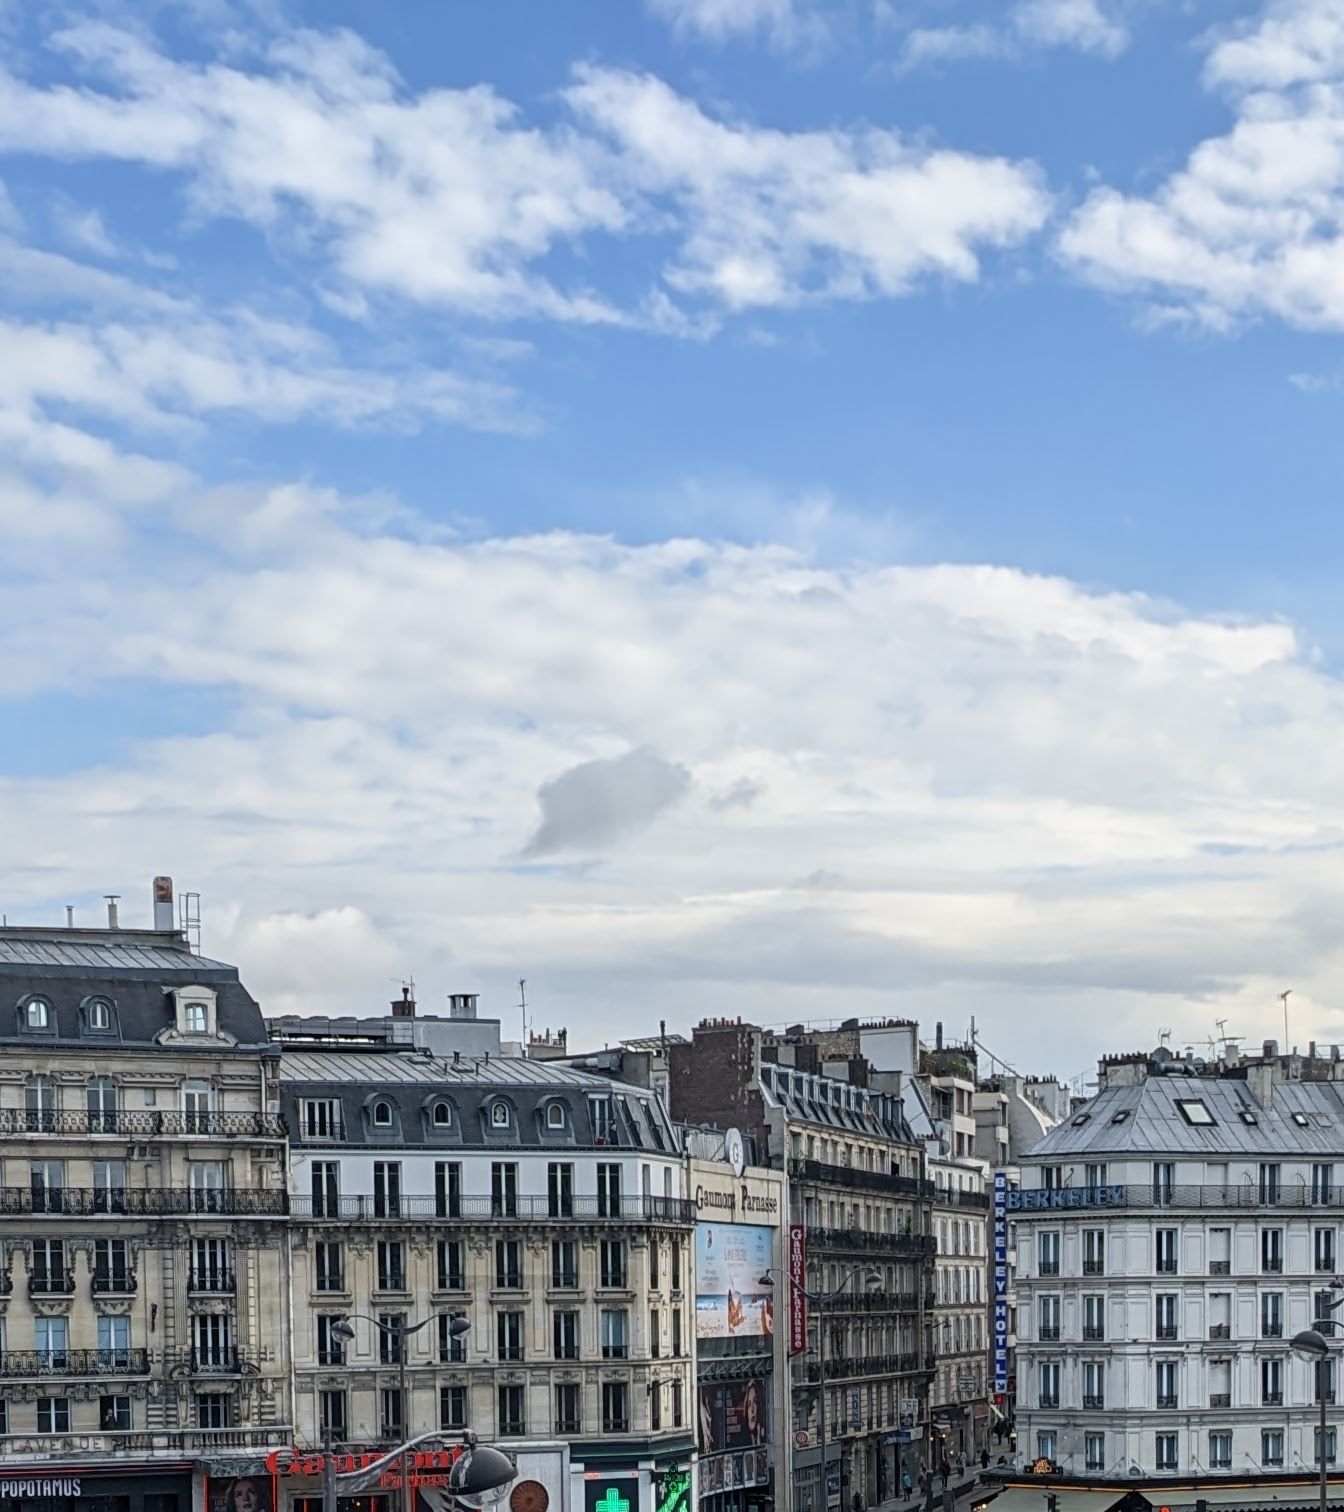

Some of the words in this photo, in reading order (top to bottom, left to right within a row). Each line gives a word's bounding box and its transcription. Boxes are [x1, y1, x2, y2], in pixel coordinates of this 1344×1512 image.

[696, 1184, 736, 1210] Gaumont
[741, 1185, 778, 1214] Parnasse
[1007, 1186, 1123, 1209] BERKELEY
[995, 1176, 1006, 1293] BERKELEY
[791, 1229, 803, 1284] Gaumont
[792, 1287, 803, 1348] Parnasse
[995, 1305, 1006, 1375] HOTEL
[265, 1445, 463, 1474] Gaumont
[380, 1473, 449, 1489] Parnass
